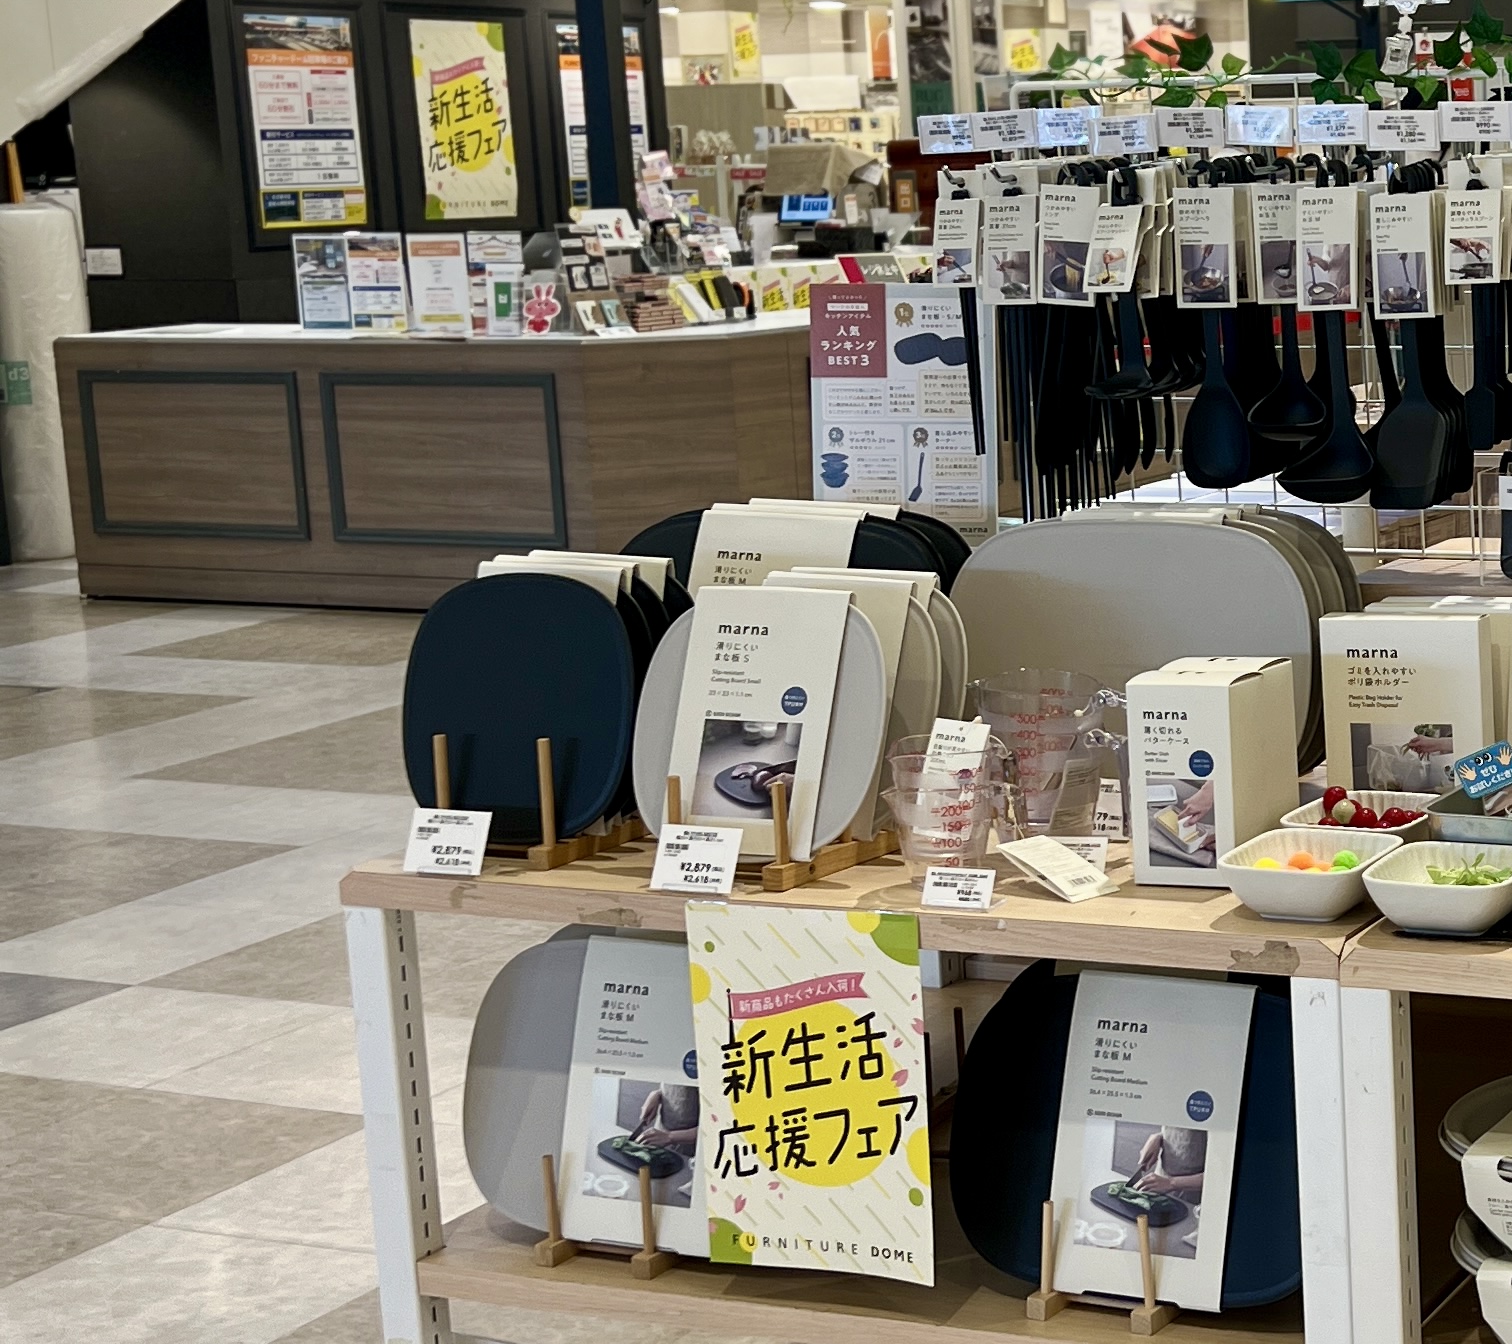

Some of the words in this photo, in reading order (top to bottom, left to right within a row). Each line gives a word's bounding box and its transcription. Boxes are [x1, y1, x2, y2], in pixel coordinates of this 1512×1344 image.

[428, 76, 495, 131] 新生活
[428, 118, 508, 173] 応援フェア
[1045, 194, 1076, 202] marna
[1257, 193, 1291, 202] marna
[1302, 197, 1334, 206] marna
[1450, 199, 1481, 207] marna
[989, 205, 1020, 213] marna
[1375, 205, 1407, 213] marna
[1099, 213, 1124, 221] marna
[836, 325, 861, 337] 人気
[820, 340, 877, 352] ランキング
[828, 355, 857, 366] BEST
[861, 354, 870, 366] 3
[717, 549, 762, 562] marna
[718, 623, 769, 636] marna
[715, 641, 759, 652] 滑りにくい
[715, 653, 740, 663] まな板
[1347, 648, 1398, 658] marna
[1347, 666, 1417, 676] ゴミを入れやすい
[1347, 677, 1410, 687] ポリ袋ホルダー
[1142, 710, 1188, 721] marna
[1143, 725, 1183, 735] 薄く切れる
[936, 732, 966, 744] marna
[1143, 737, 1190, 745] バターケース
[940, 805, 962, 817] 200
[680, 861, 712, 873] ¥2,879
[944, 856, 960, 867] 50
[603, 982, 650, 996] marna
[738, 979, 857, 1014] 新商品もたくさん入荷!
[1097, 1018, 1149, 1034] marna
[1094, 1037, 1138, 1049] 滑りにくい
[720, 1011, 888, 1104] 新生活
[713, 1094, 919, 1181] 応援フェア
[731, 1233, 860, 1257] FURNITURE
[870, 1245, 915, 1264] DOME
